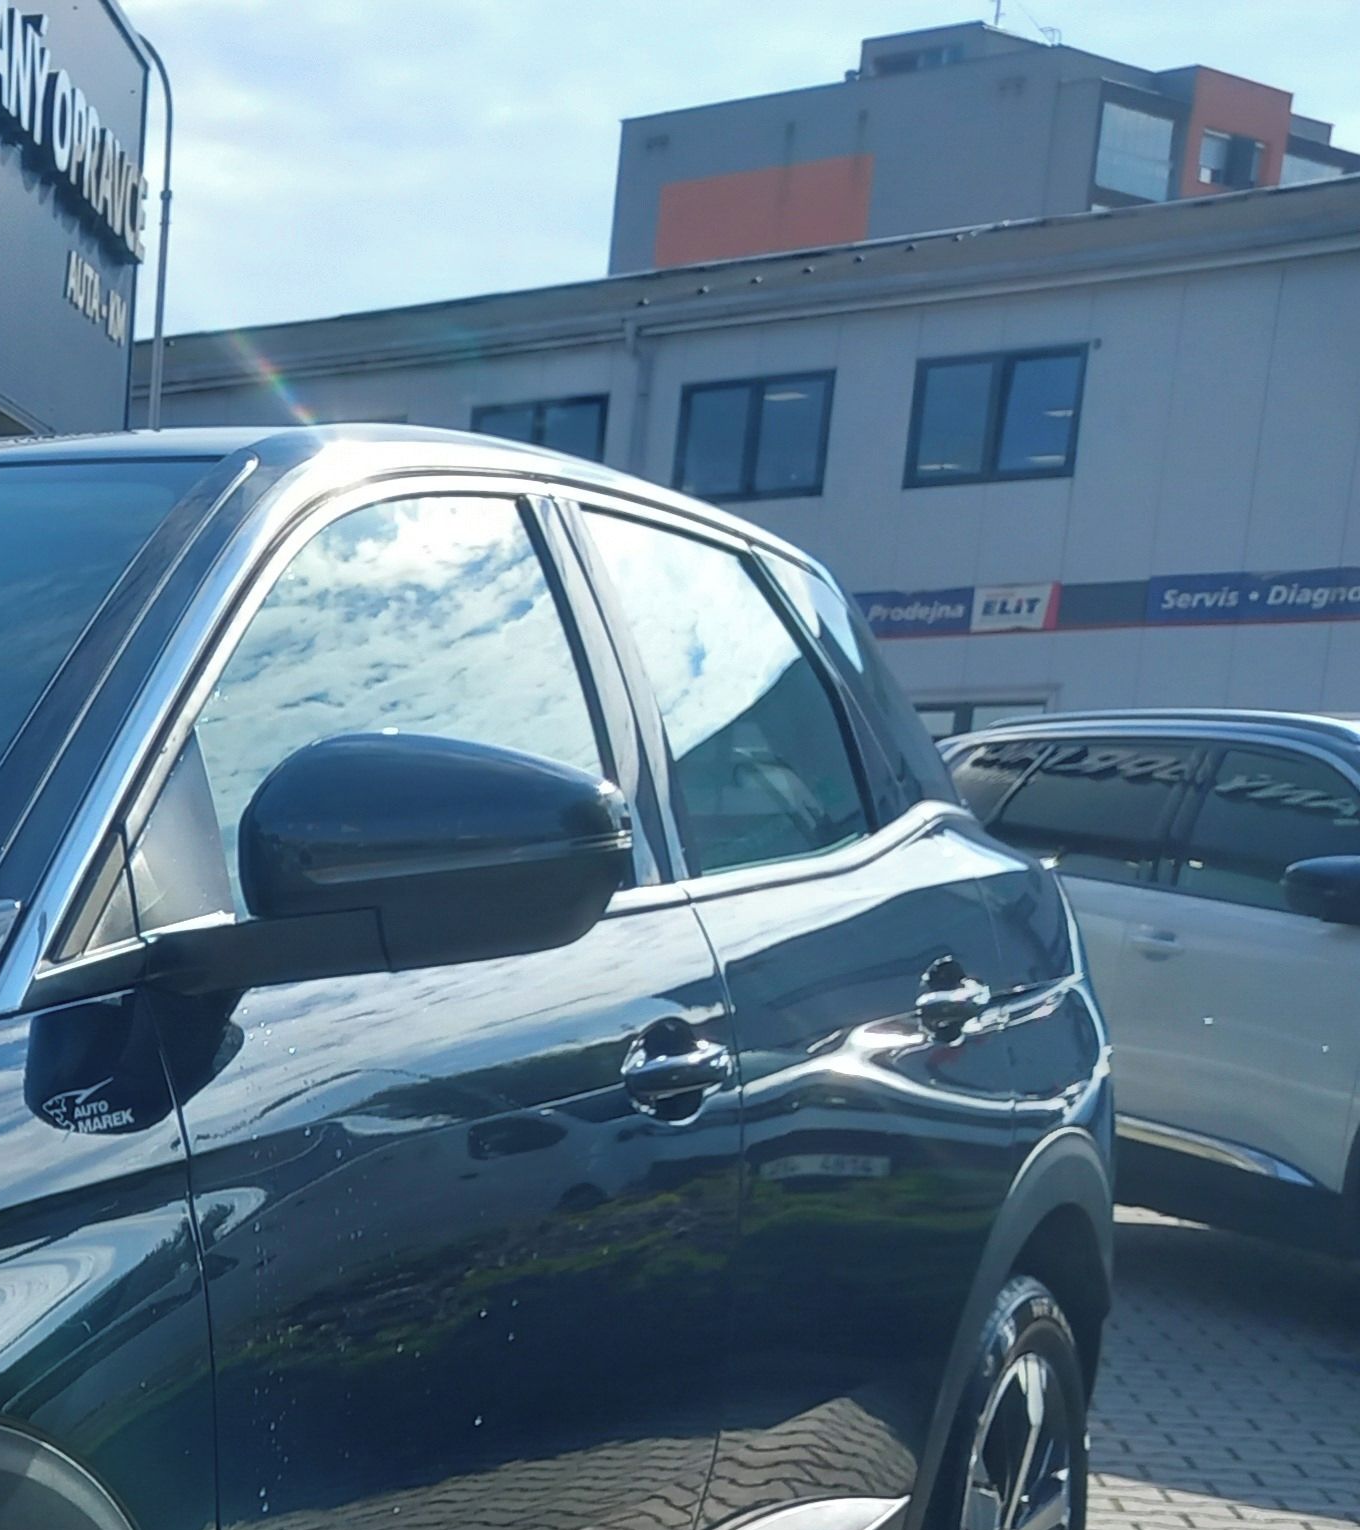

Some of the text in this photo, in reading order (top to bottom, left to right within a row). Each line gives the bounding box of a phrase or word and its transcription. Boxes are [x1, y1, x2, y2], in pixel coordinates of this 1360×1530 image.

[52, 69, 148, 264] OPRAVCE
[982, 597, 1041, 616] ELIT
[1161, 586, 1239, 610] Servis
[867, 600, 966, 624] Prodejna
[74, 1100, 109, 1119] AUTO
[77, 1108, 135, 1133] MAREK
